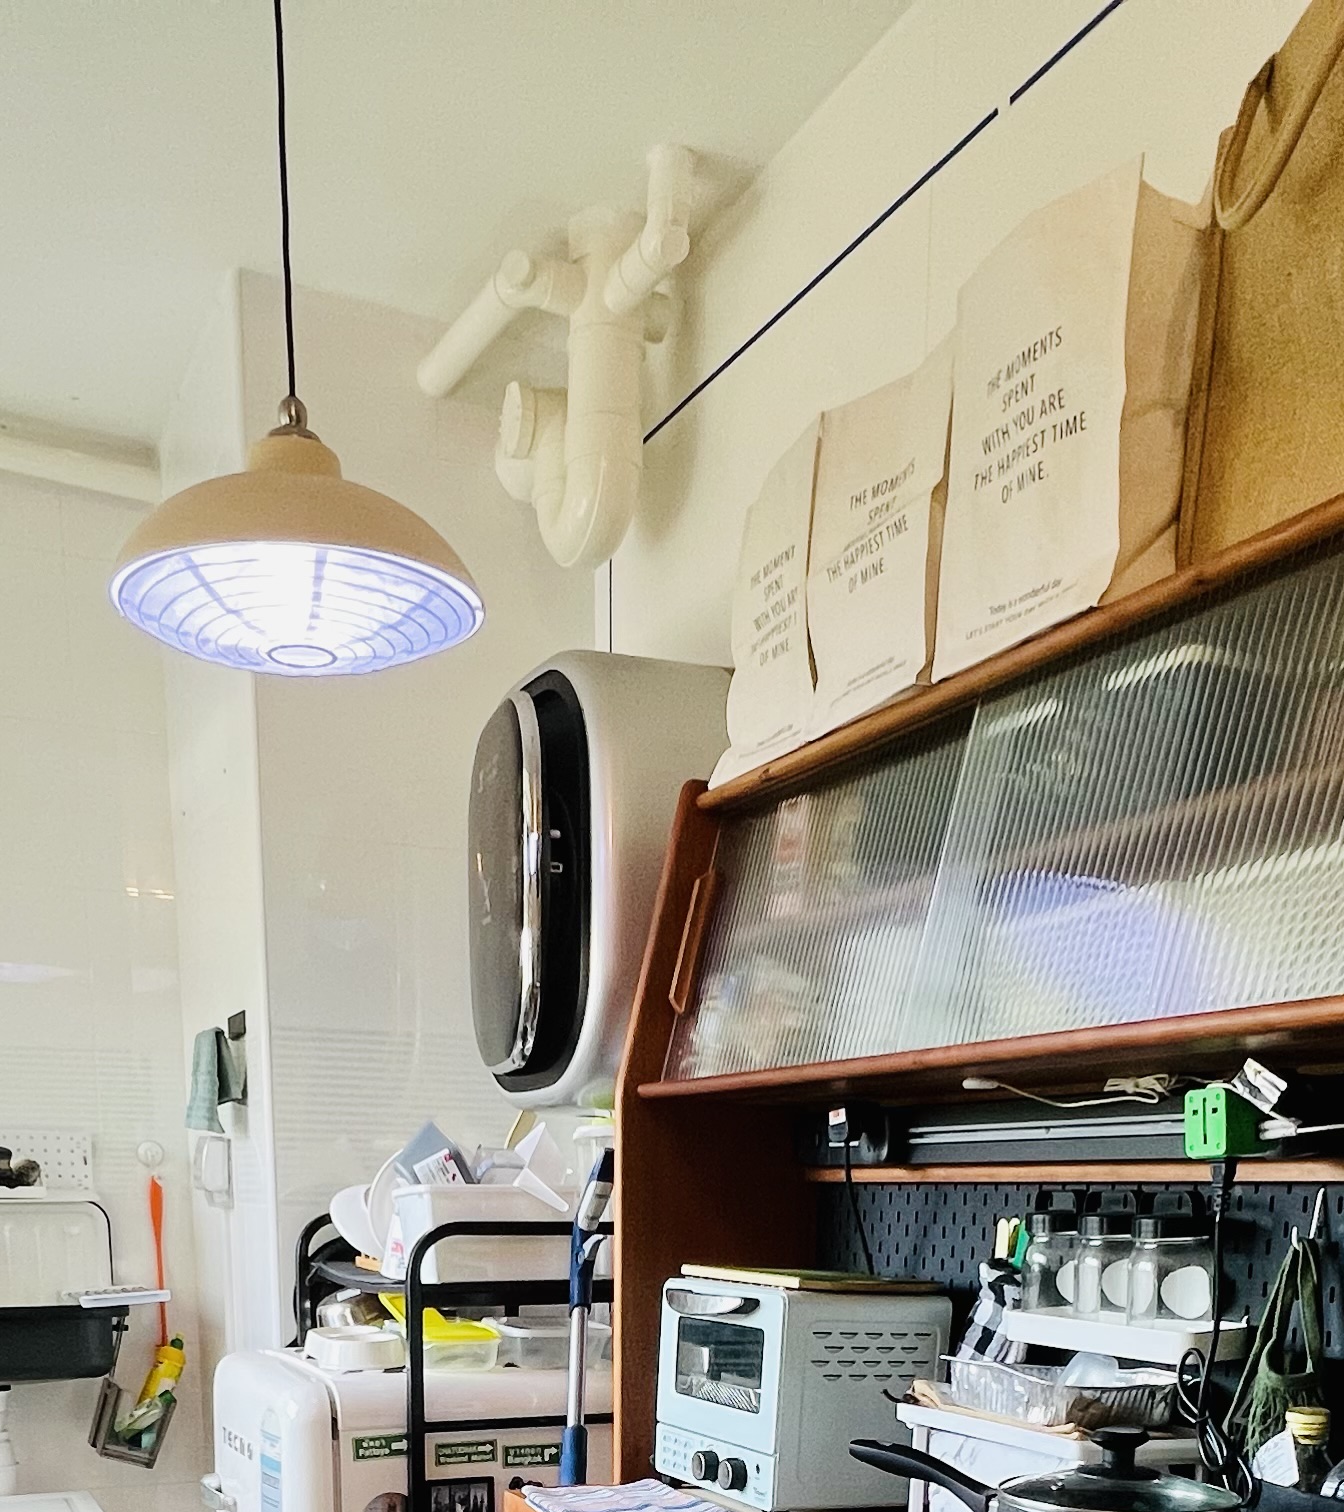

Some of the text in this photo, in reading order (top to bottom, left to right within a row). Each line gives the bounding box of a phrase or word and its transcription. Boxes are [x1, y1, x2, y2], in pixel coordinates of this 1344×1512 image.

[987, 325, 1063, 398] THE MOMENTS
[1001, 373, 1036, 413] SPENT
[981, 388, 1065, 456] WITH YOU ARE
[974, 411, 1087, 491] THE HAPPIEST TIME
[849, 490, 868, 511] THE
[1001, 480, 1013, 504] OF
[867, 496, 898, 525] SPENT
[826, 559, 843, 584] THE
[842, 531, 884, 571] HAPPIEST
[885, 515, 909, 544] TIME
[763, 574, 784, 602] SPENT
[848, 574, 859, 595] OF
[770, 597, 787, 623] YOU
